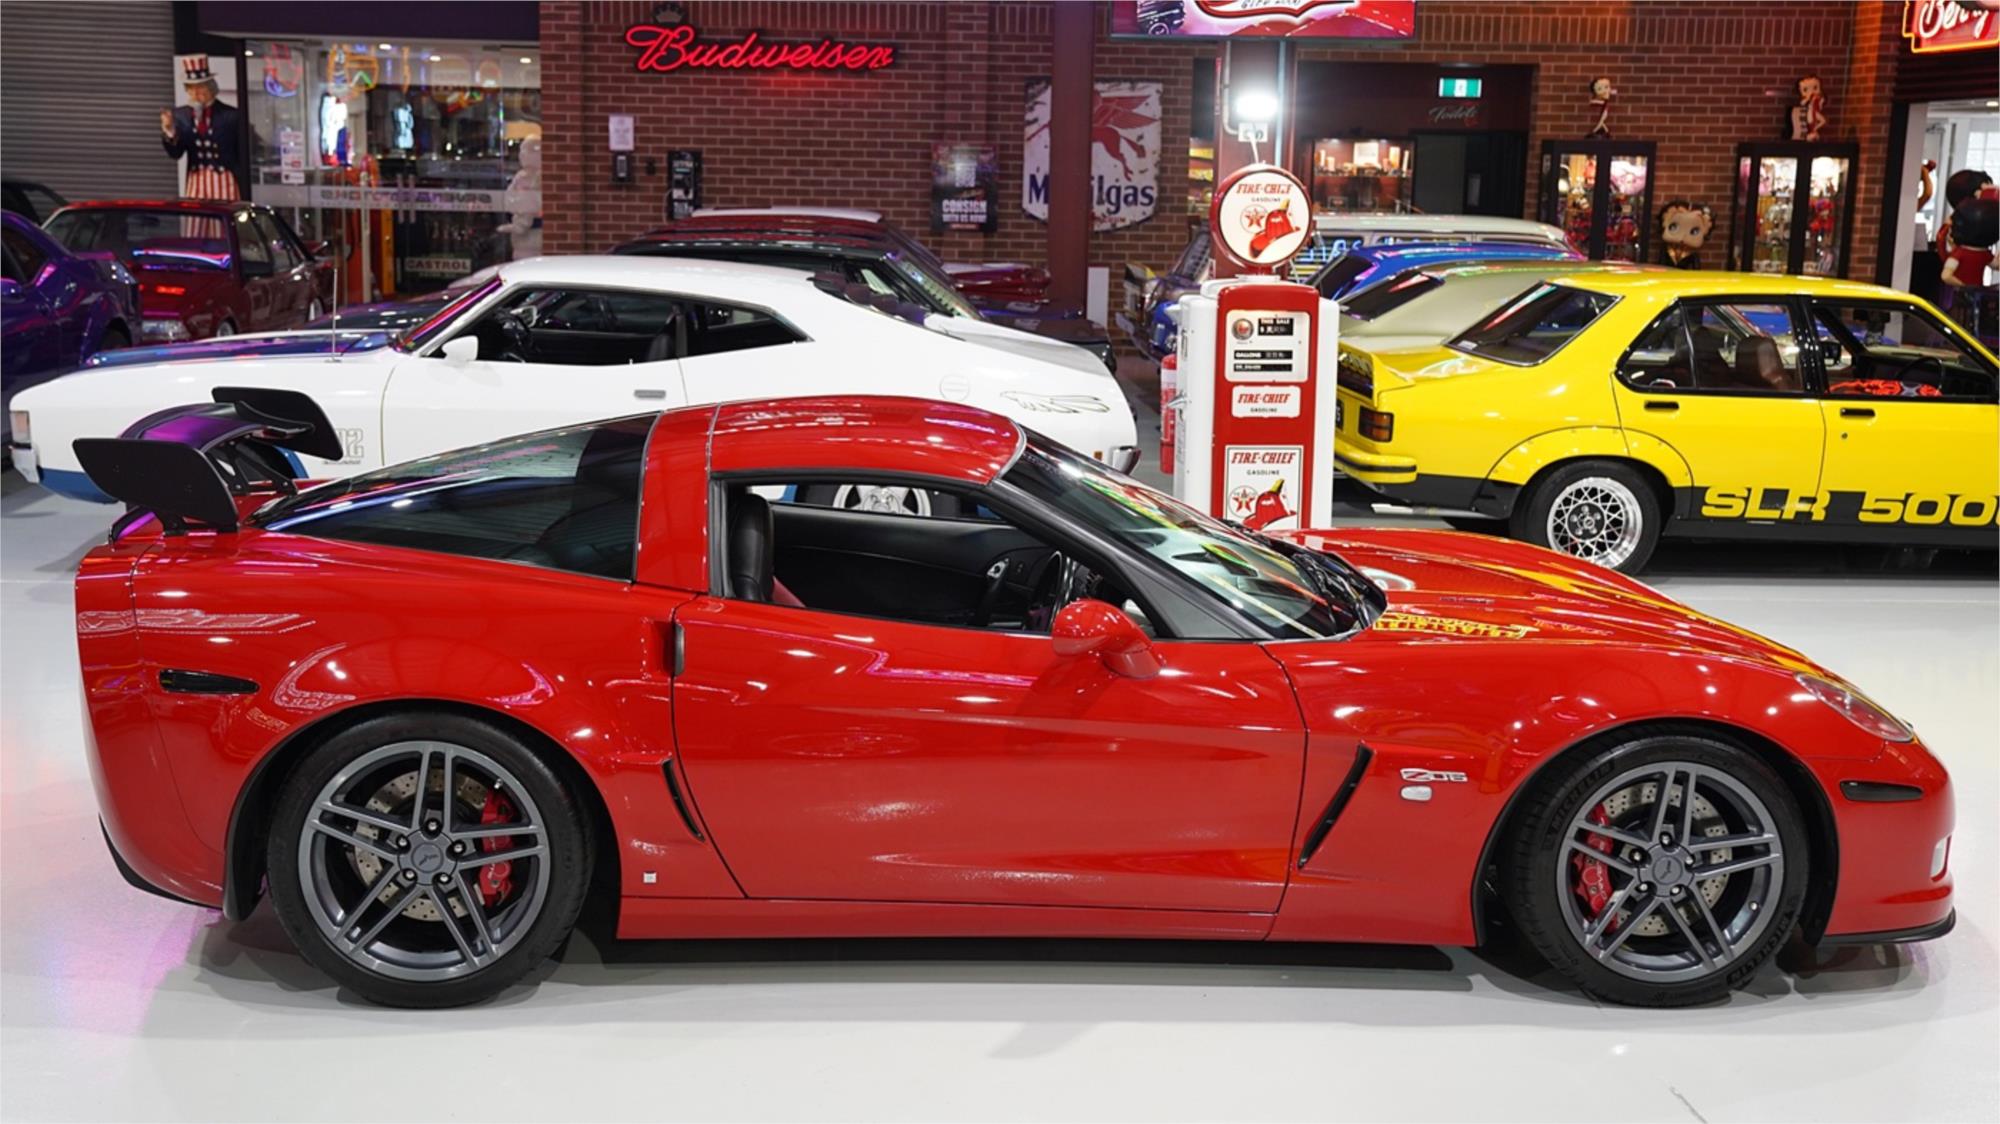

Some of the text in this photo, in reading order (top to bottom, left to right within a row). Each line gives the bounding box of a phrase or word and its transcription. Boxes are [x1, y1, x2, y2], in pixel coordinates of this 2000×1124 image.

[625, 25, 894, 71] Budweiser
[1701, 486, 1999, 527] SLR 500
